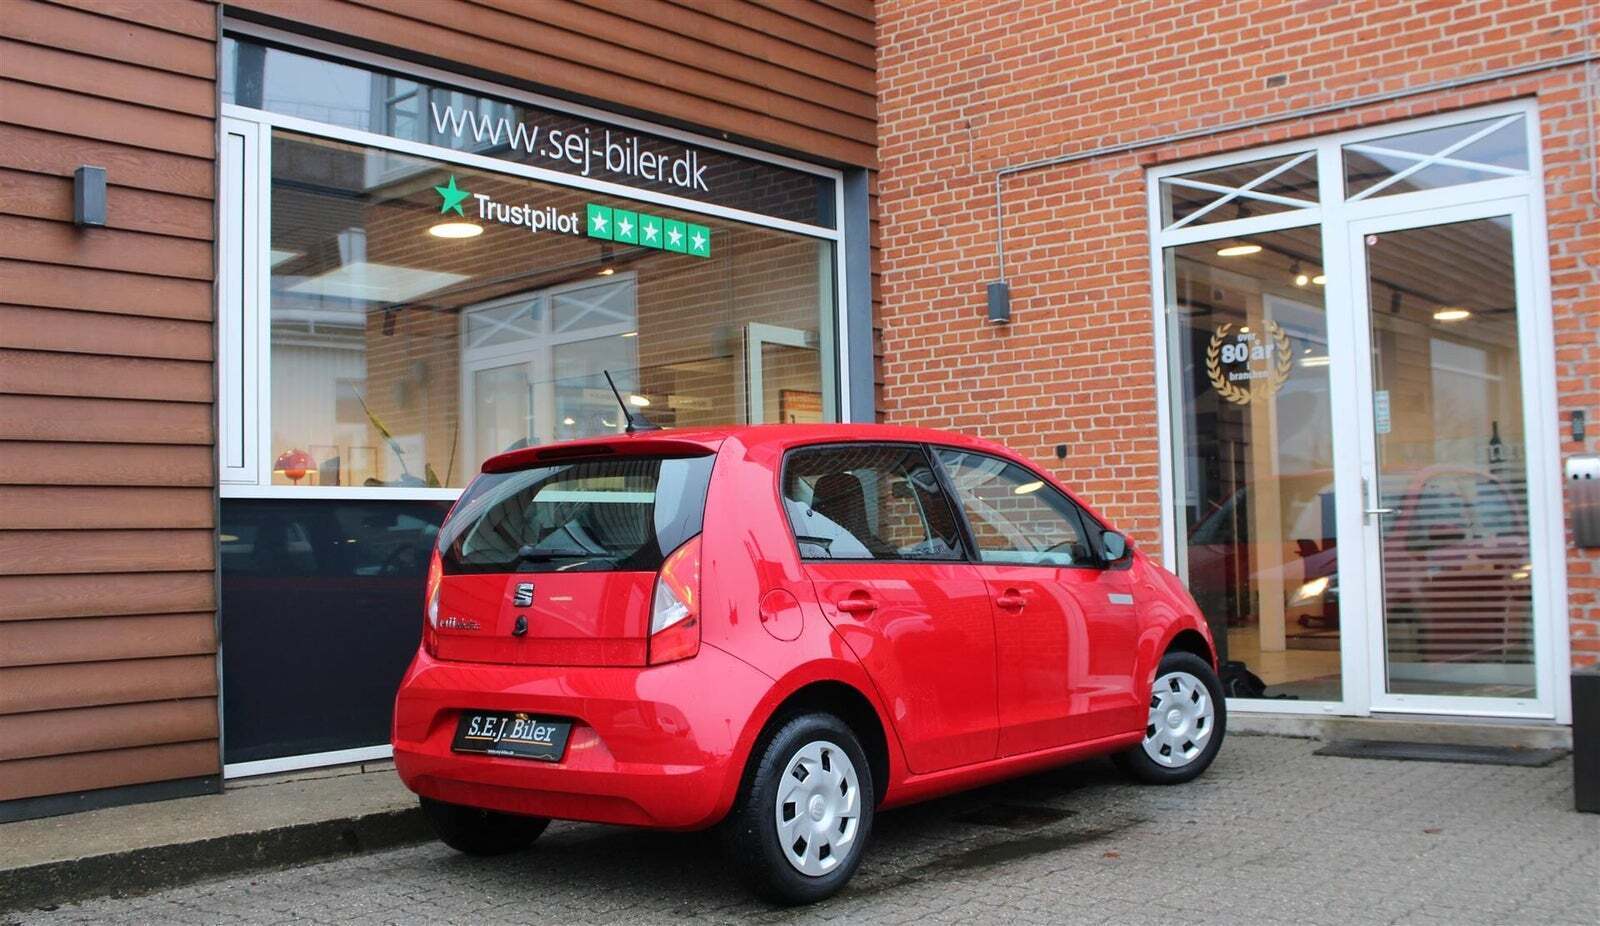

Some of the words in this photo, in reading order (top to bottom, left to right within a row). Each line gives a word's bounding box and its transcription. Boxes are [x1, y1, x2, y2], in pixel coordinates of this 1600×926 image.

[431, 101, 709, 192] www.sej-biler.dk
[473, 193, 579, 234] Trustpilot
[1221, 343, 1249, 364] 80
[468, 716, 508, 743] S.E.J.
[510, 718, 556, 742] Biler
